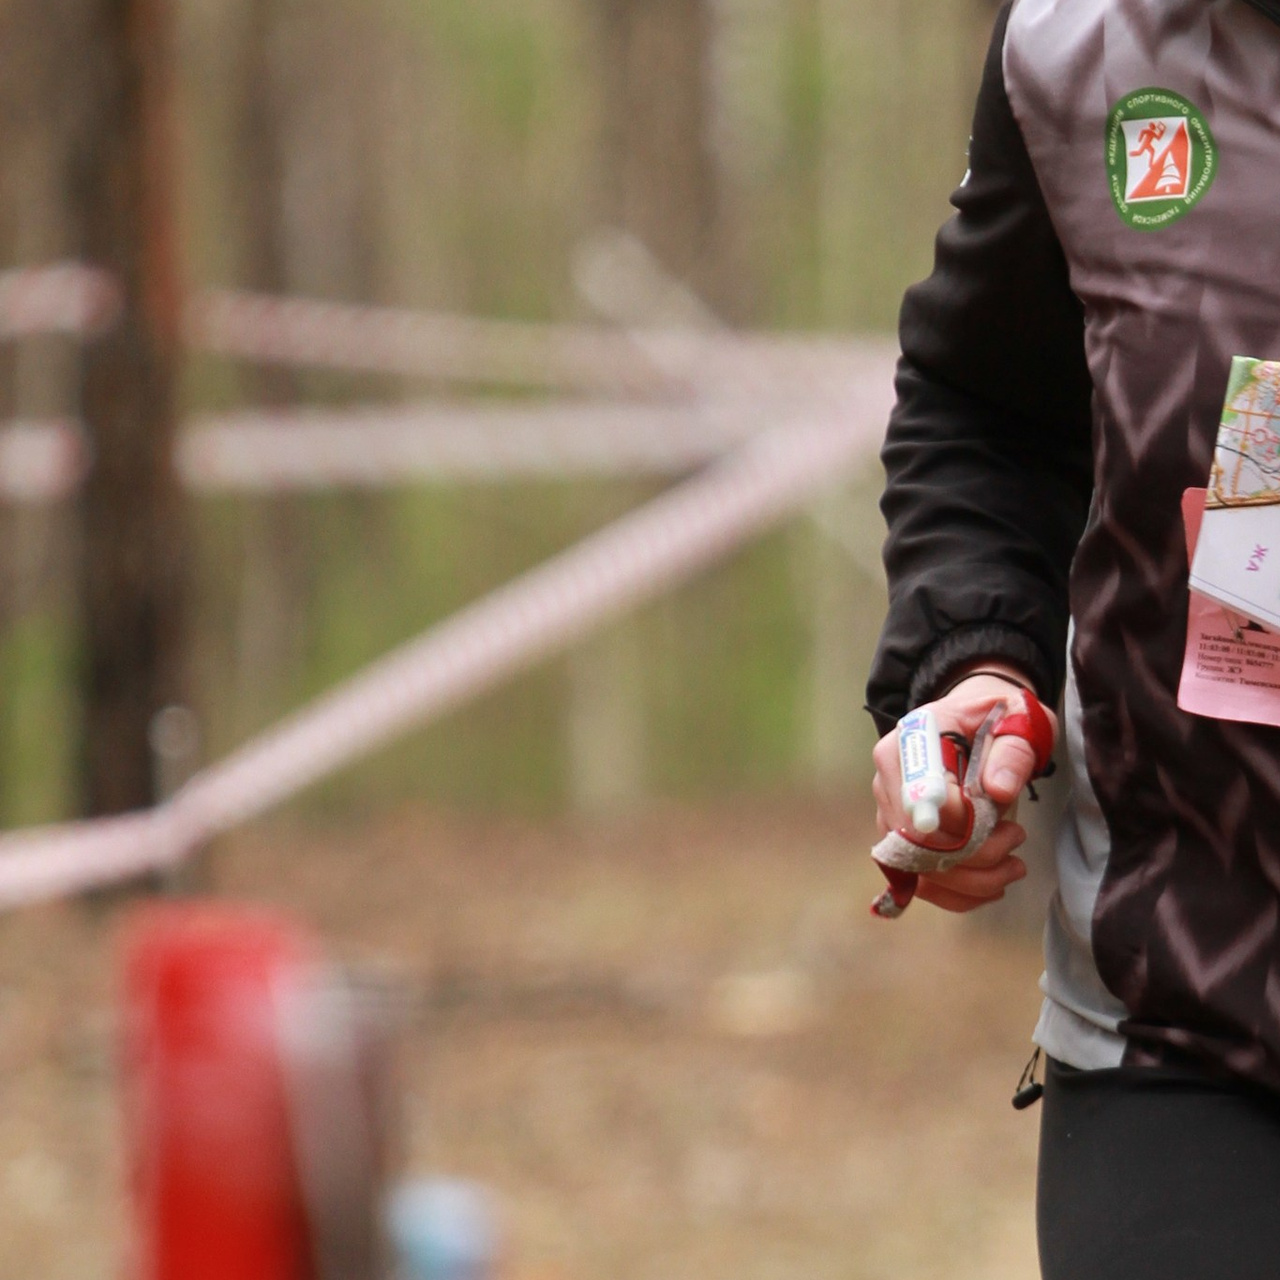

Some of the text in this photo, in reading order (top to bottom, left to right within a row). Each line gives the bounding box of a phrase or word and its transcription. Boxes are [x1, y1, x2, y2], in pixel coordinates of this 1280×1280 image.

[1109, 109, 1125, 166] ФЕДЕРАЦИЯ
[1126, 93, 1190, 115] СПОРТИВНОГО
[1184, 117, 1214, 205] ОРИЕНТИРОВАНИЯ
